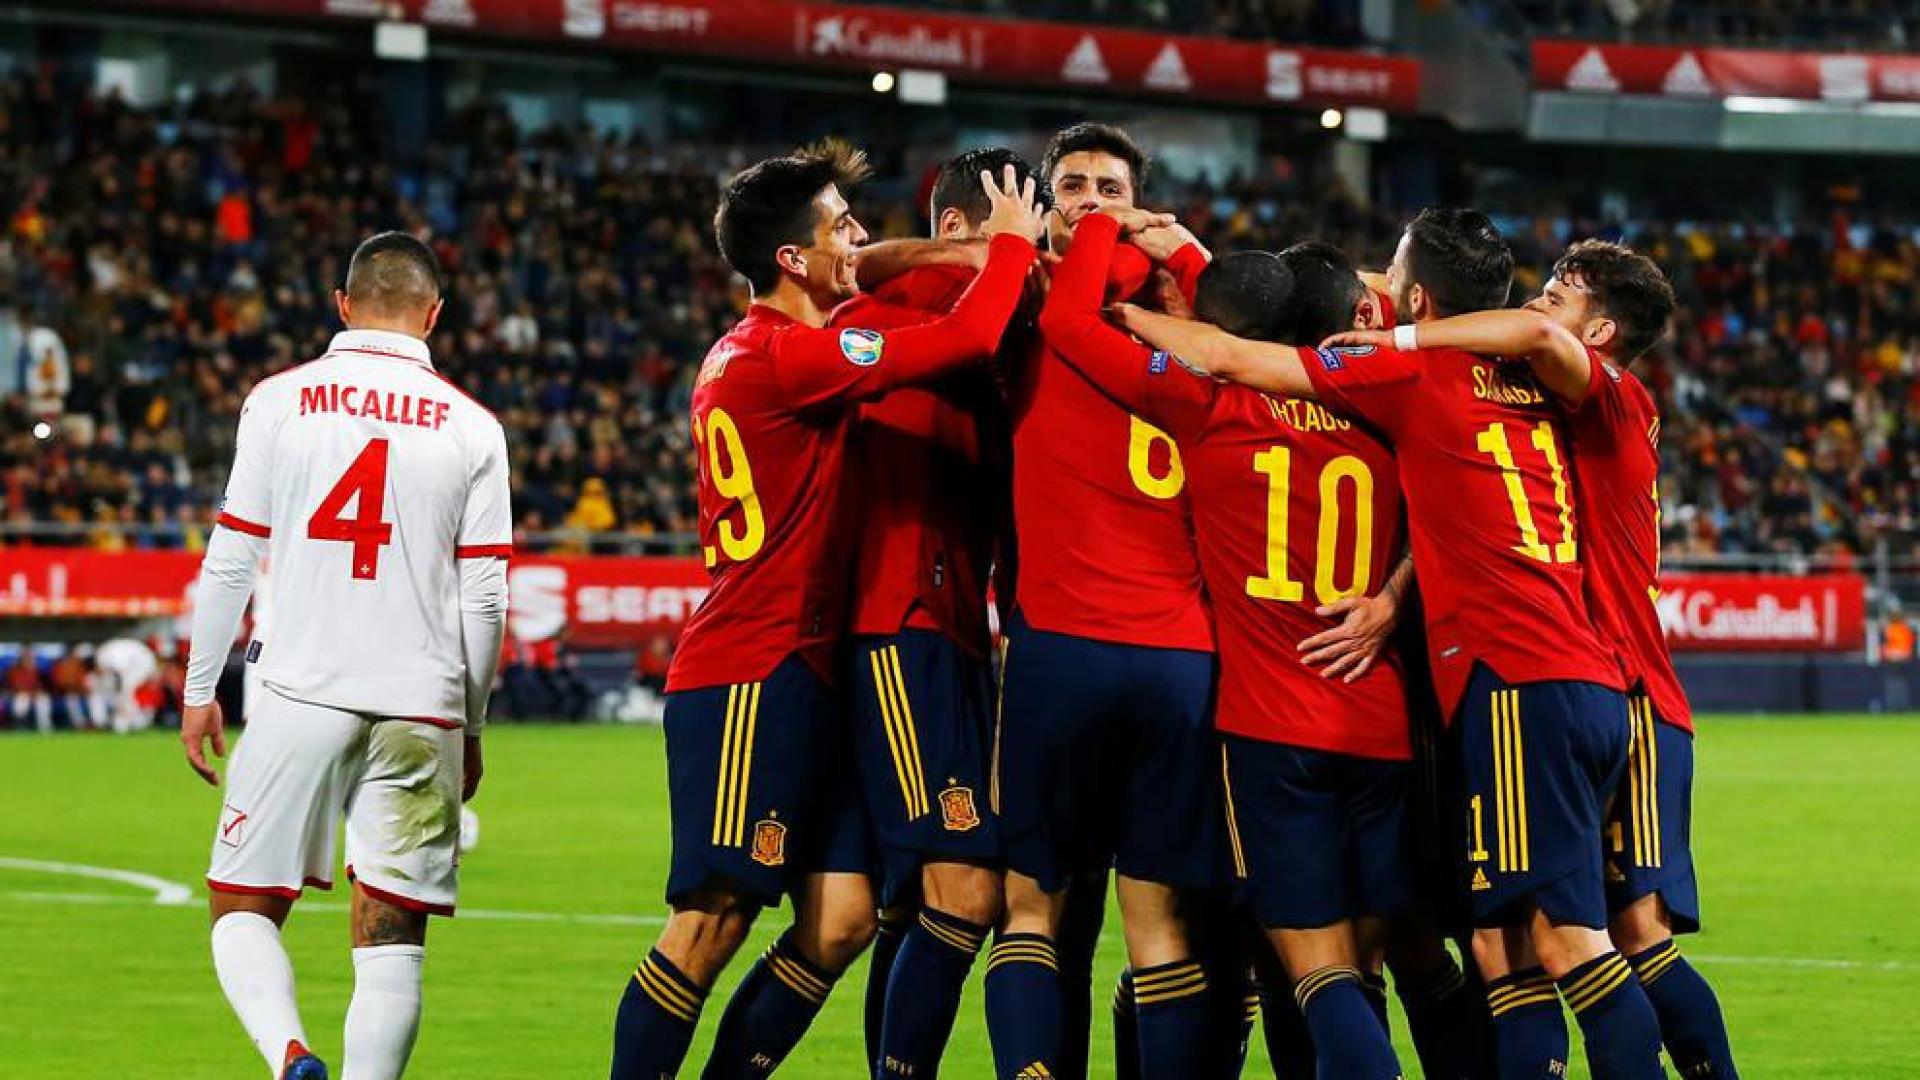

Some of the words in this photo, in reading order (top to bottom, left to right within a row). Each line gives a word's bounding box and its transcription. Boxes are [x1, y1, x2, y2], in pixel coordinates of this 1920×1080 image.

[300, 384, 450, 430] MICALLEF
[1128, 414, 1185, 498] 6
[307, 437, 392, 580] 4
[1247, 446, 1373, 604] 10
[1477, 421, 1577, 562] 11
